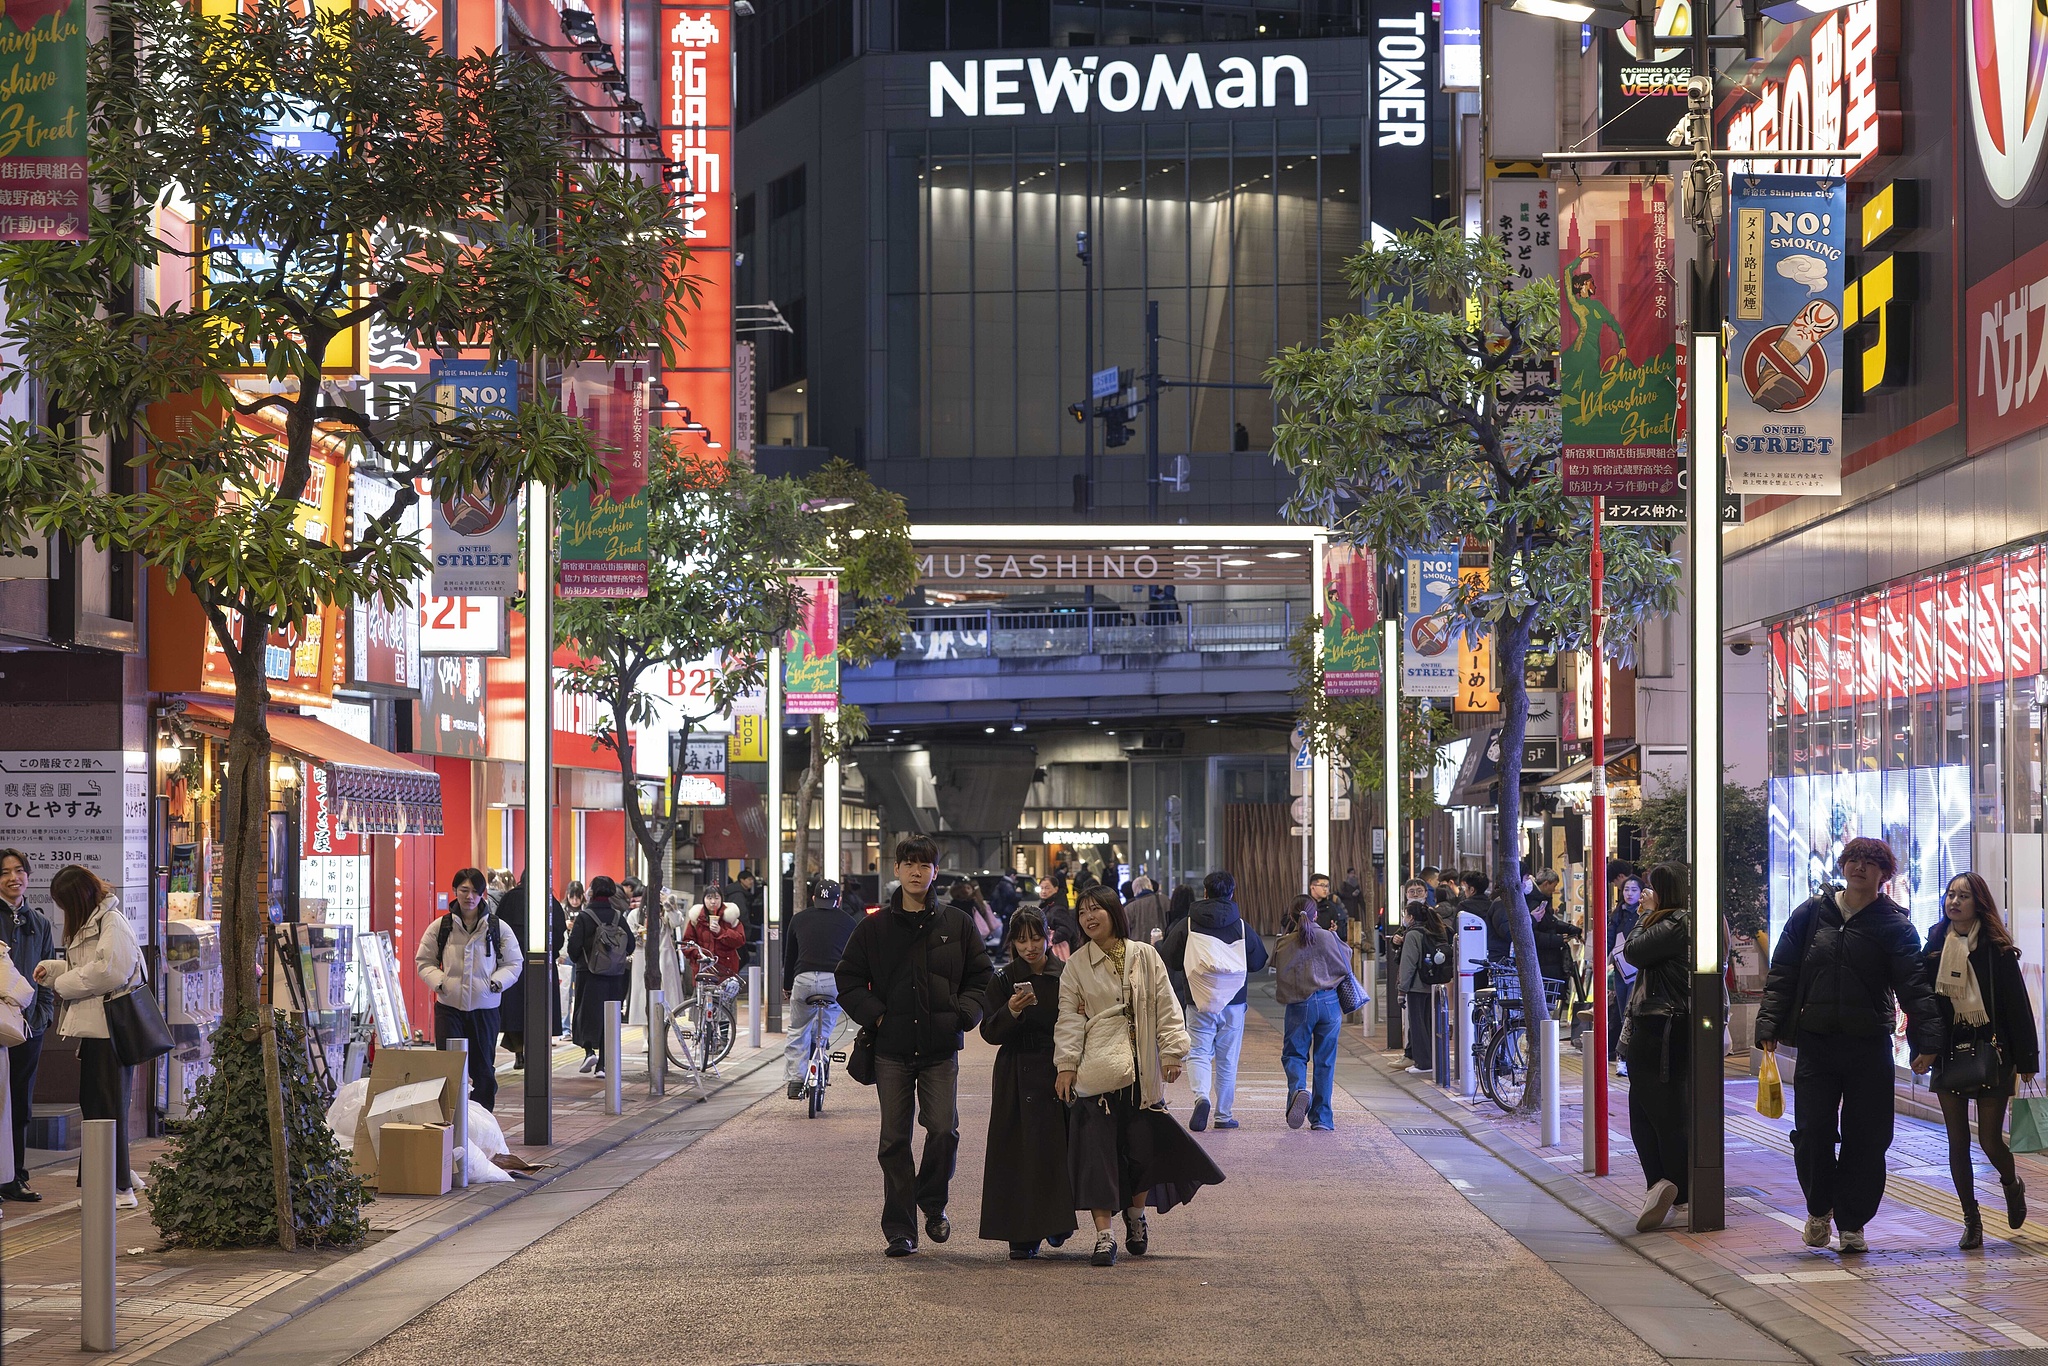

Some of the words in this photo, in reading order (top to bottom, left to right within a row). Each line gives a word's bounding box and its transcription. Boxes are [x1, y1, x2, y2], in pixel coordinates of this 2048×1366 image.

[672, 50, 682, 126] TAITO
[929, 52, 1309, 118] NEWoMan
[1379, 12, 1426, 148] TOWER
[1620, 73, 1691, 86] VEGAS
[0, 102, 80, 157] Street
[684, 50, 719, 239] GAME
[1743, 188, 1768, 197] 新宿区
[1769, 189, 1813, 198] Shinjuku
[1814, 191, 1835, 199] City
[1535, 212, 1551, 247] そば
[1770, 211, 1831, 236] NO!
[1517, 226, 1533, 280] うどん
[1653, 201, 1668, 319] 環境美化と安全・安心
[1770, 237, 1842, 261] SMOKING
[1744, 216, 1757, 311] ダメ！路上喫煙
[1600, 353, 1672, 391] Shinjuku
[459, 386, 507, 405] NO!
[1620, 411, 1673, 447] Street
[1763, 424, 1780, 435] ON
[1781, 424, 1806, 436] THE
[1565, 447, 1677, 460] 新宿東口商店街振興組合
[1735, 435, 1834, 455] STREET
[1569, 464, 1590, 476] 協力
[1592, 464, 1674, 476] 新宿武蔵野商栄会
[1569, 480, 1659, 493] 防犯カメラ作動中
[590, 493, 645, 522] Shinjuku
[436, 553, 513, 568] STREET
[458, 545, 472, 553] ON
[473, 545, 491, 553] THE
[604, 536, 645, 562] Street
[916, 554, 1159, 579] MUSASHINO
[1183, 554, 1243, 579] ST.
[1423, 560, 1452, 573] NO!
[1423, 573, 1458, 585] SMOKING
[1407, 668, 1456, 677] STREET
[743, 715, 753, 746] HOP
[19, 758, 104, 768] この階段で2階へ
[1528, 748, 1546, 762] 5F
[5, 801, 103, 818] ひとやすみ
